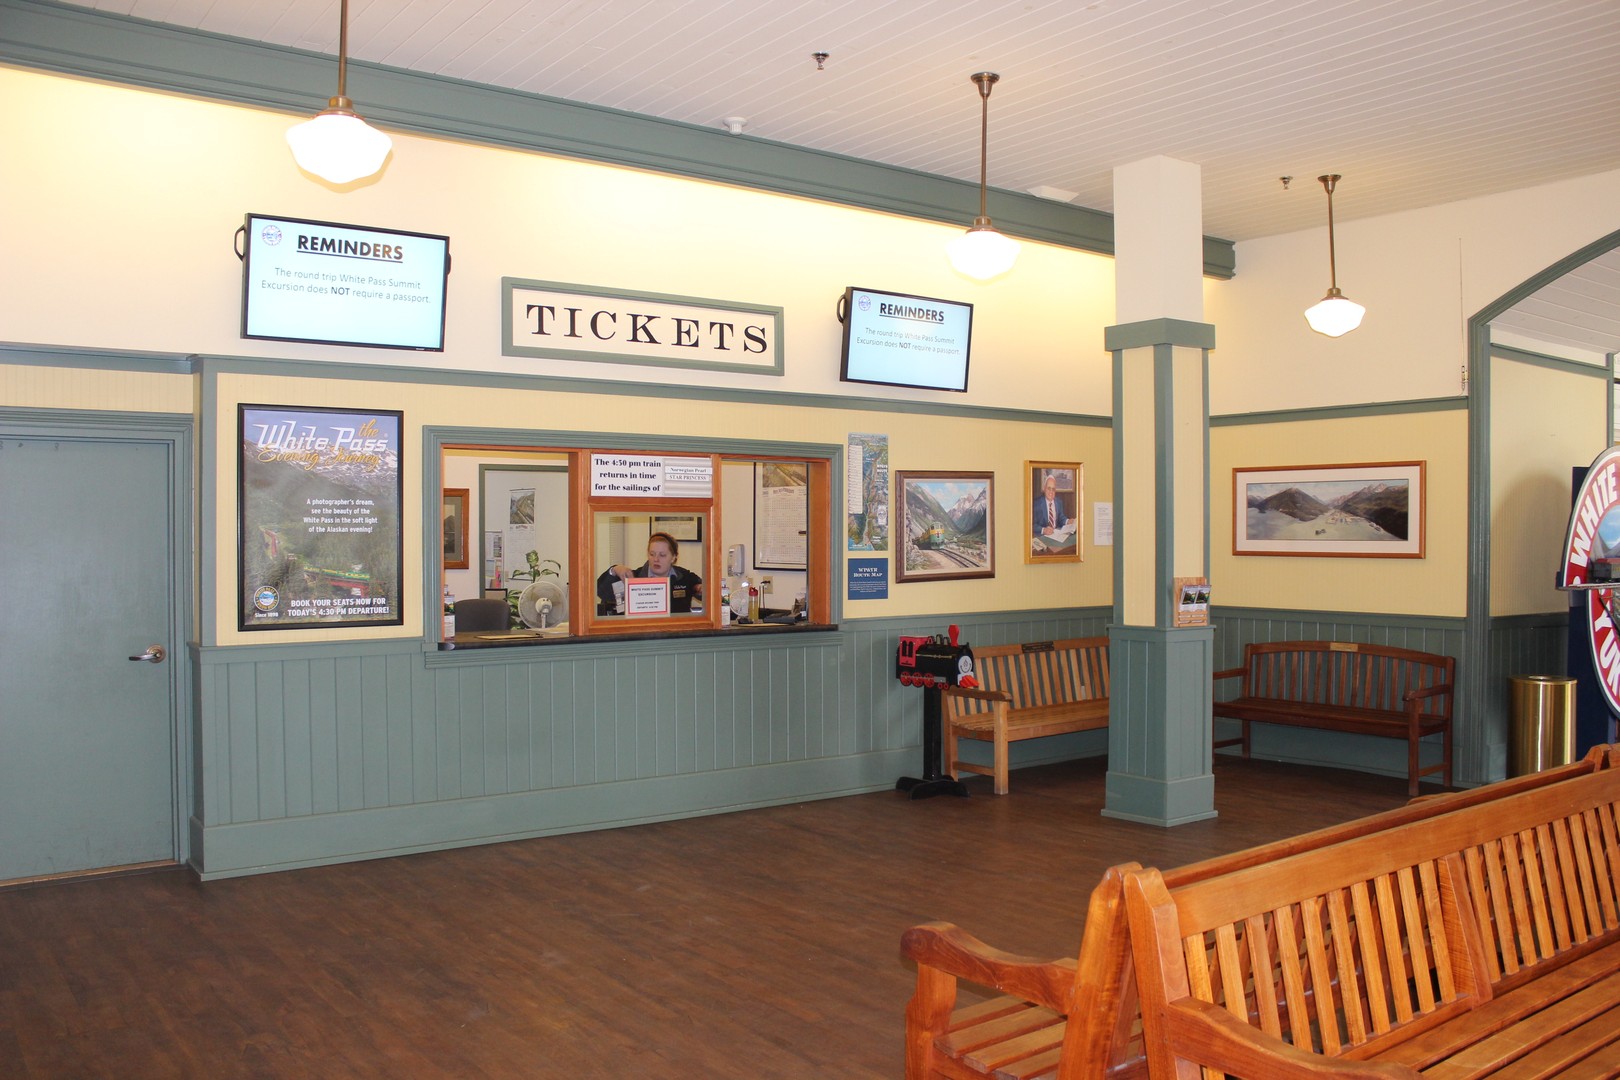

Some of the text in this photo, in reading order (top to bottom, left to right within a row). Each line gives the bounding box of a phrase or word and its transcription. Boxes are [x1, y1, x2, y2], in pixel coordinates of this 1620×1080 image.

[298, 234, 404, 260] REMINDERS
[275, 267, 421, 290] The round trip White Pass Summit
[262, 280, 304, 292] Excursion
[307, 284, 328, 294] does
[330, 286, 350, 296] NOT
[352, 288, 384, 300] require
[393, 293, 431, 304] passport.
[880, 302, 944, 322] REMINDERS
[526, 304, 768, 354] TICKETS
[866, 328, 955, 345] The round trip White Pass Summit
[857, 337, 884, 346] Excursion
[885, 340, 898, 348] does
[912, 344, 931, 353] require
[252, 420, 388, 452] White Pass
[358, 418, 379, 438] the
[258, 443, 380, 472] Evening Journey
[594, 458, 610, 466] The
[599, 471, 628, 479] returns
[622, 484, 651, 492] sailings
[365, 517, 378, 525] light
[1570, 463, 1618, 568] WHITE
[349, 526, 373, 534] evening!
[312, 599, 331, 607] YOUR
[333, 598, 354, 606] SEATS
[356, 598, 371, 606] NOW
[373, 597, 386, 605] FOR
[288, 609, 317, 617] TODAY'S
[336, 607, 347, 615] PM
[348, 606, 390, 615] DEPARTURE!
